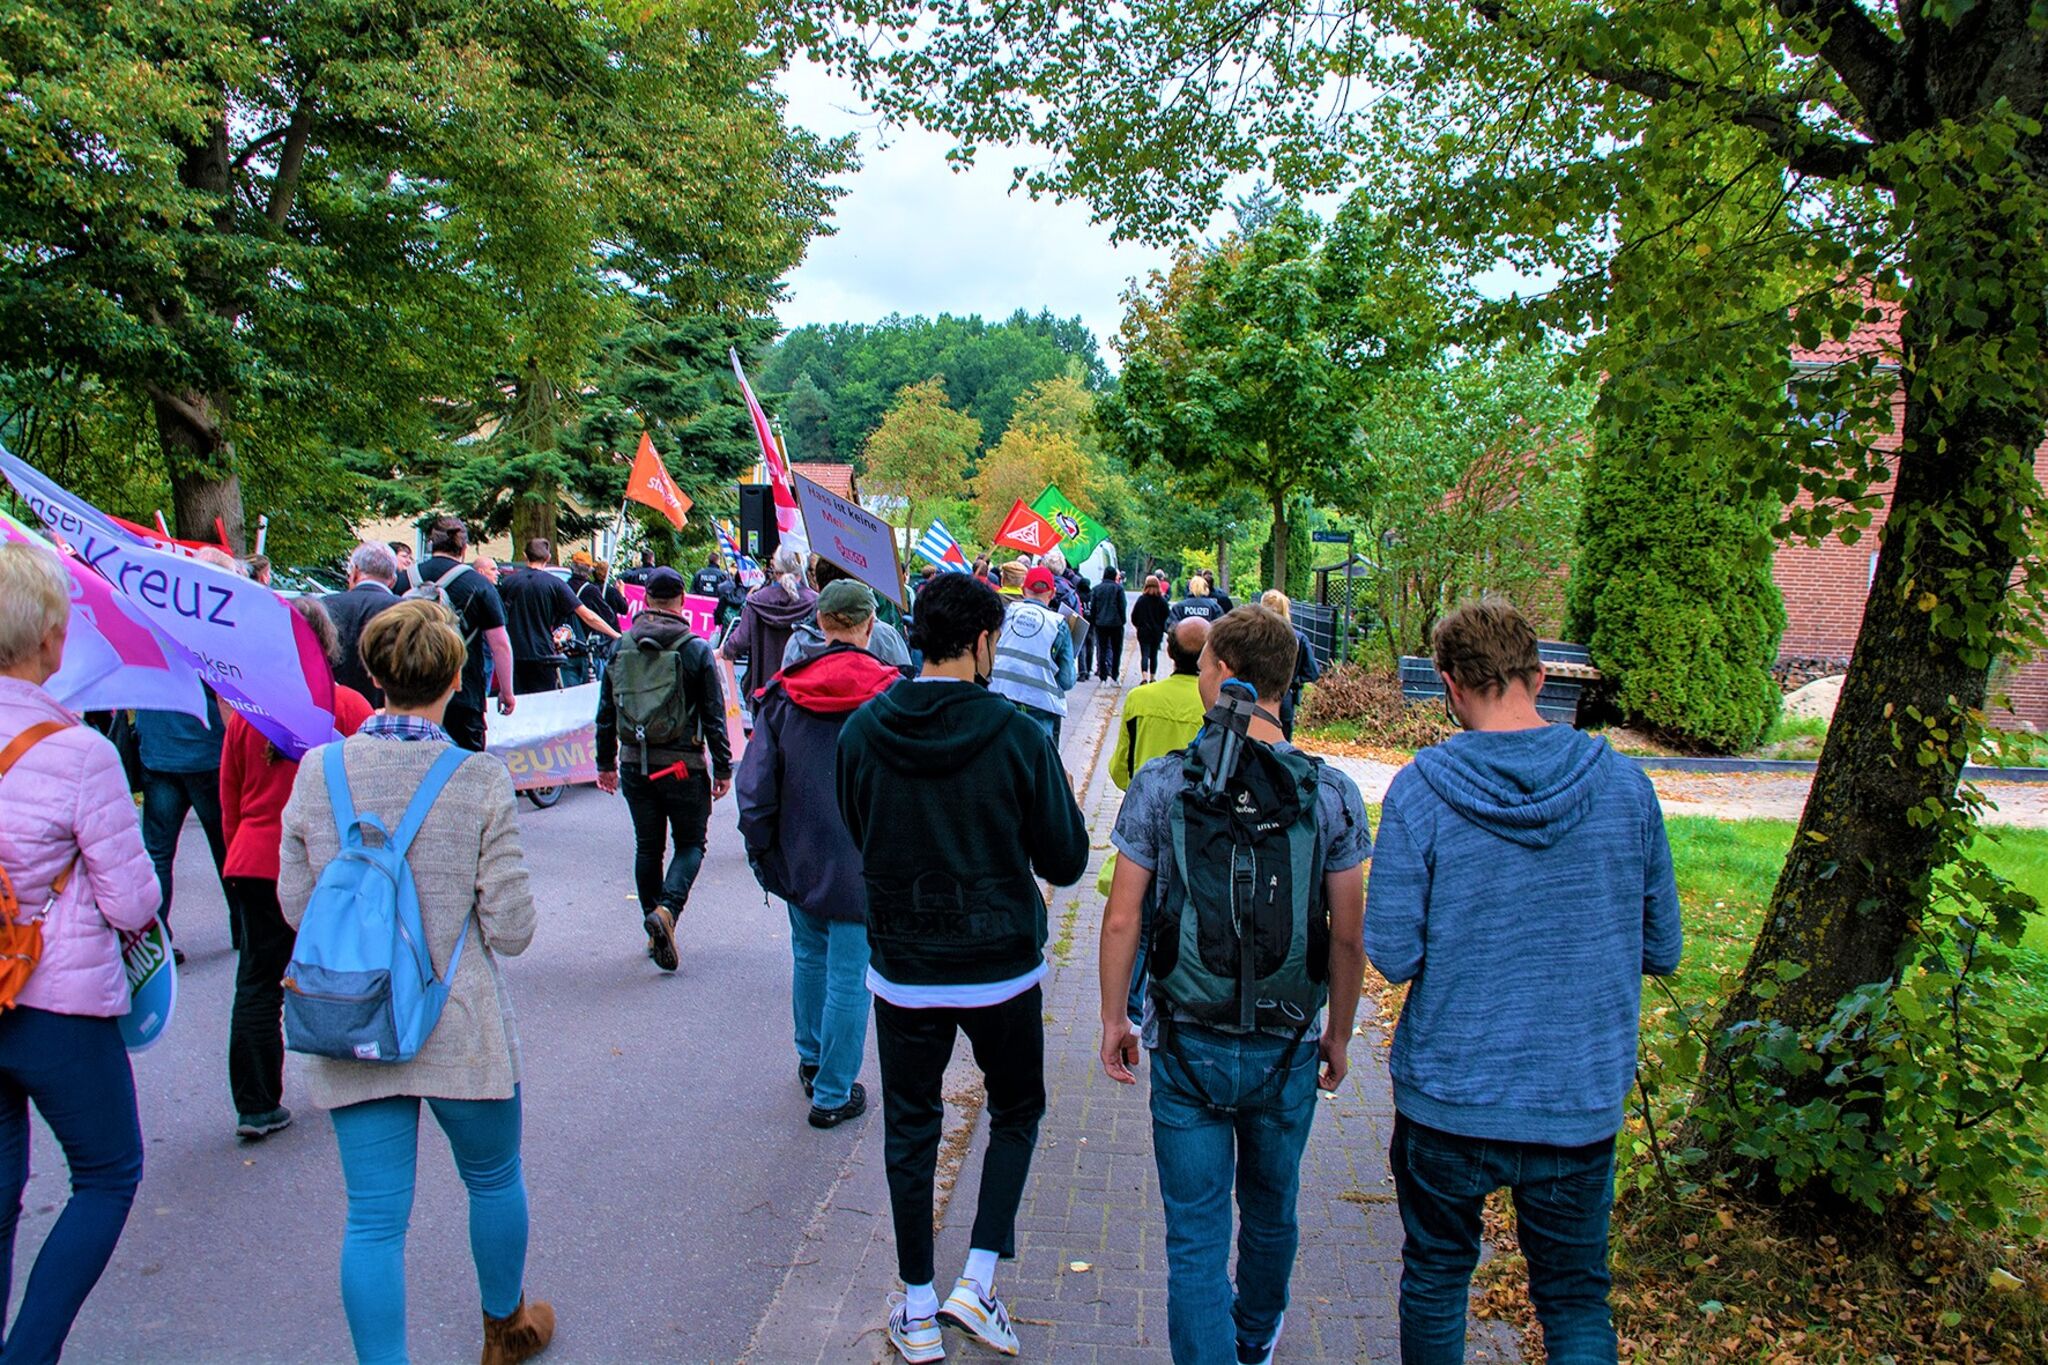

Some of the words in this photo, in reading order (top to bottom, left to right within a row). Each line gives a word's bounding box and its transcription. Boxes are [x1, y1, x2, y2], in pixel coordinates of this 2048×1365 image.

[833, 499, 847, 515] ist
[848, 508, 878, 533] keine
[84, 536, 236, 628] Kreuz
[1184, 606, 1209, 616] POLIZEI
[127, 931, 164, 987] MUS
